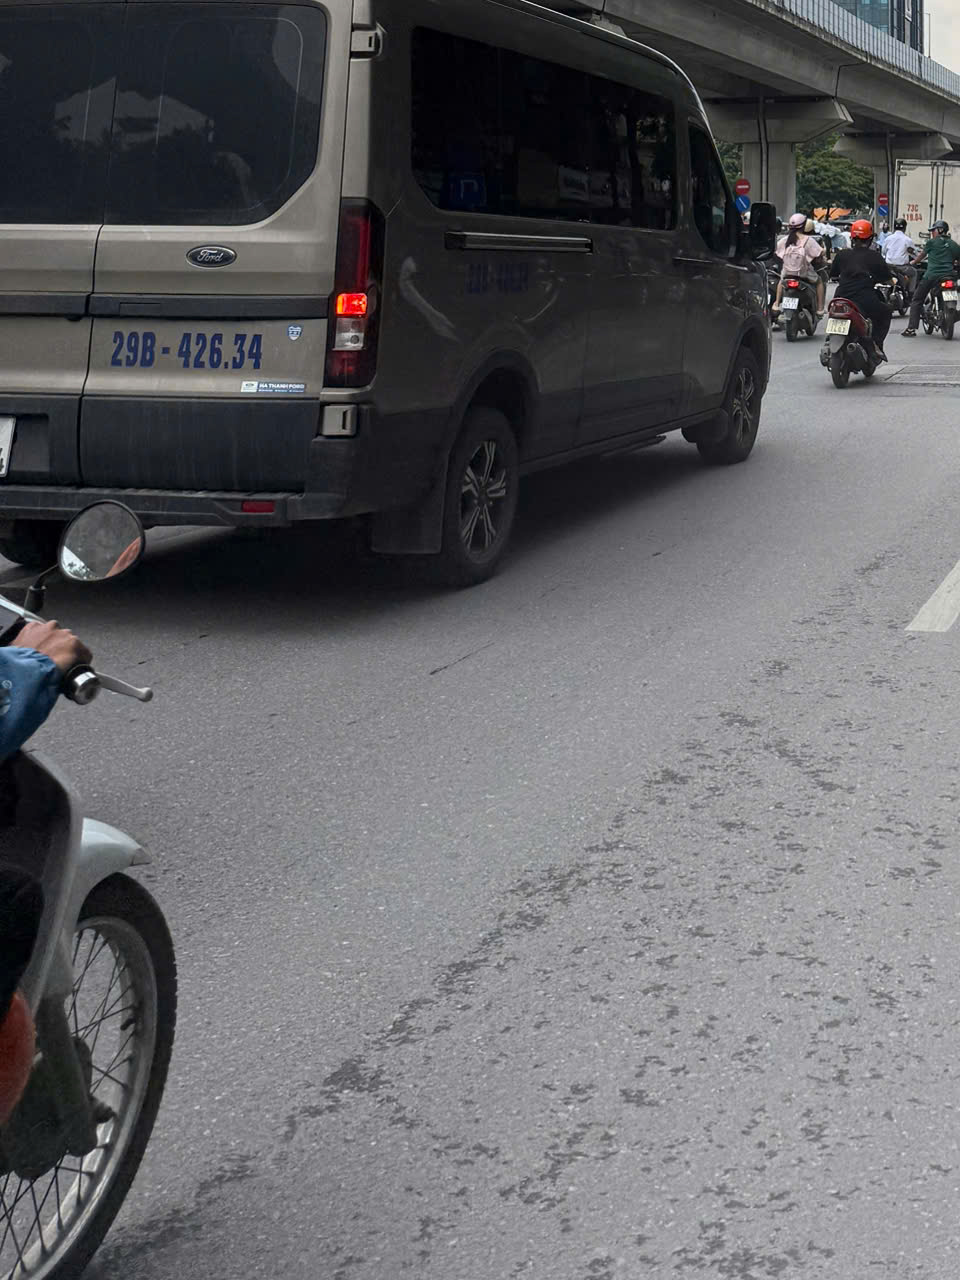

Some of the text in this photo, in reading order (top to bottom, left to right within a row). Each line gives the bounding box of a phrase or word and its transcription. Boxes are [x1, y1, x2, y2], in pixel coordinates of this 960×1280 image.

[196, 249, 225, 263] Ford
[110, 331, 156, 368] 29B
[177, 332, 263, 370] 426.34
